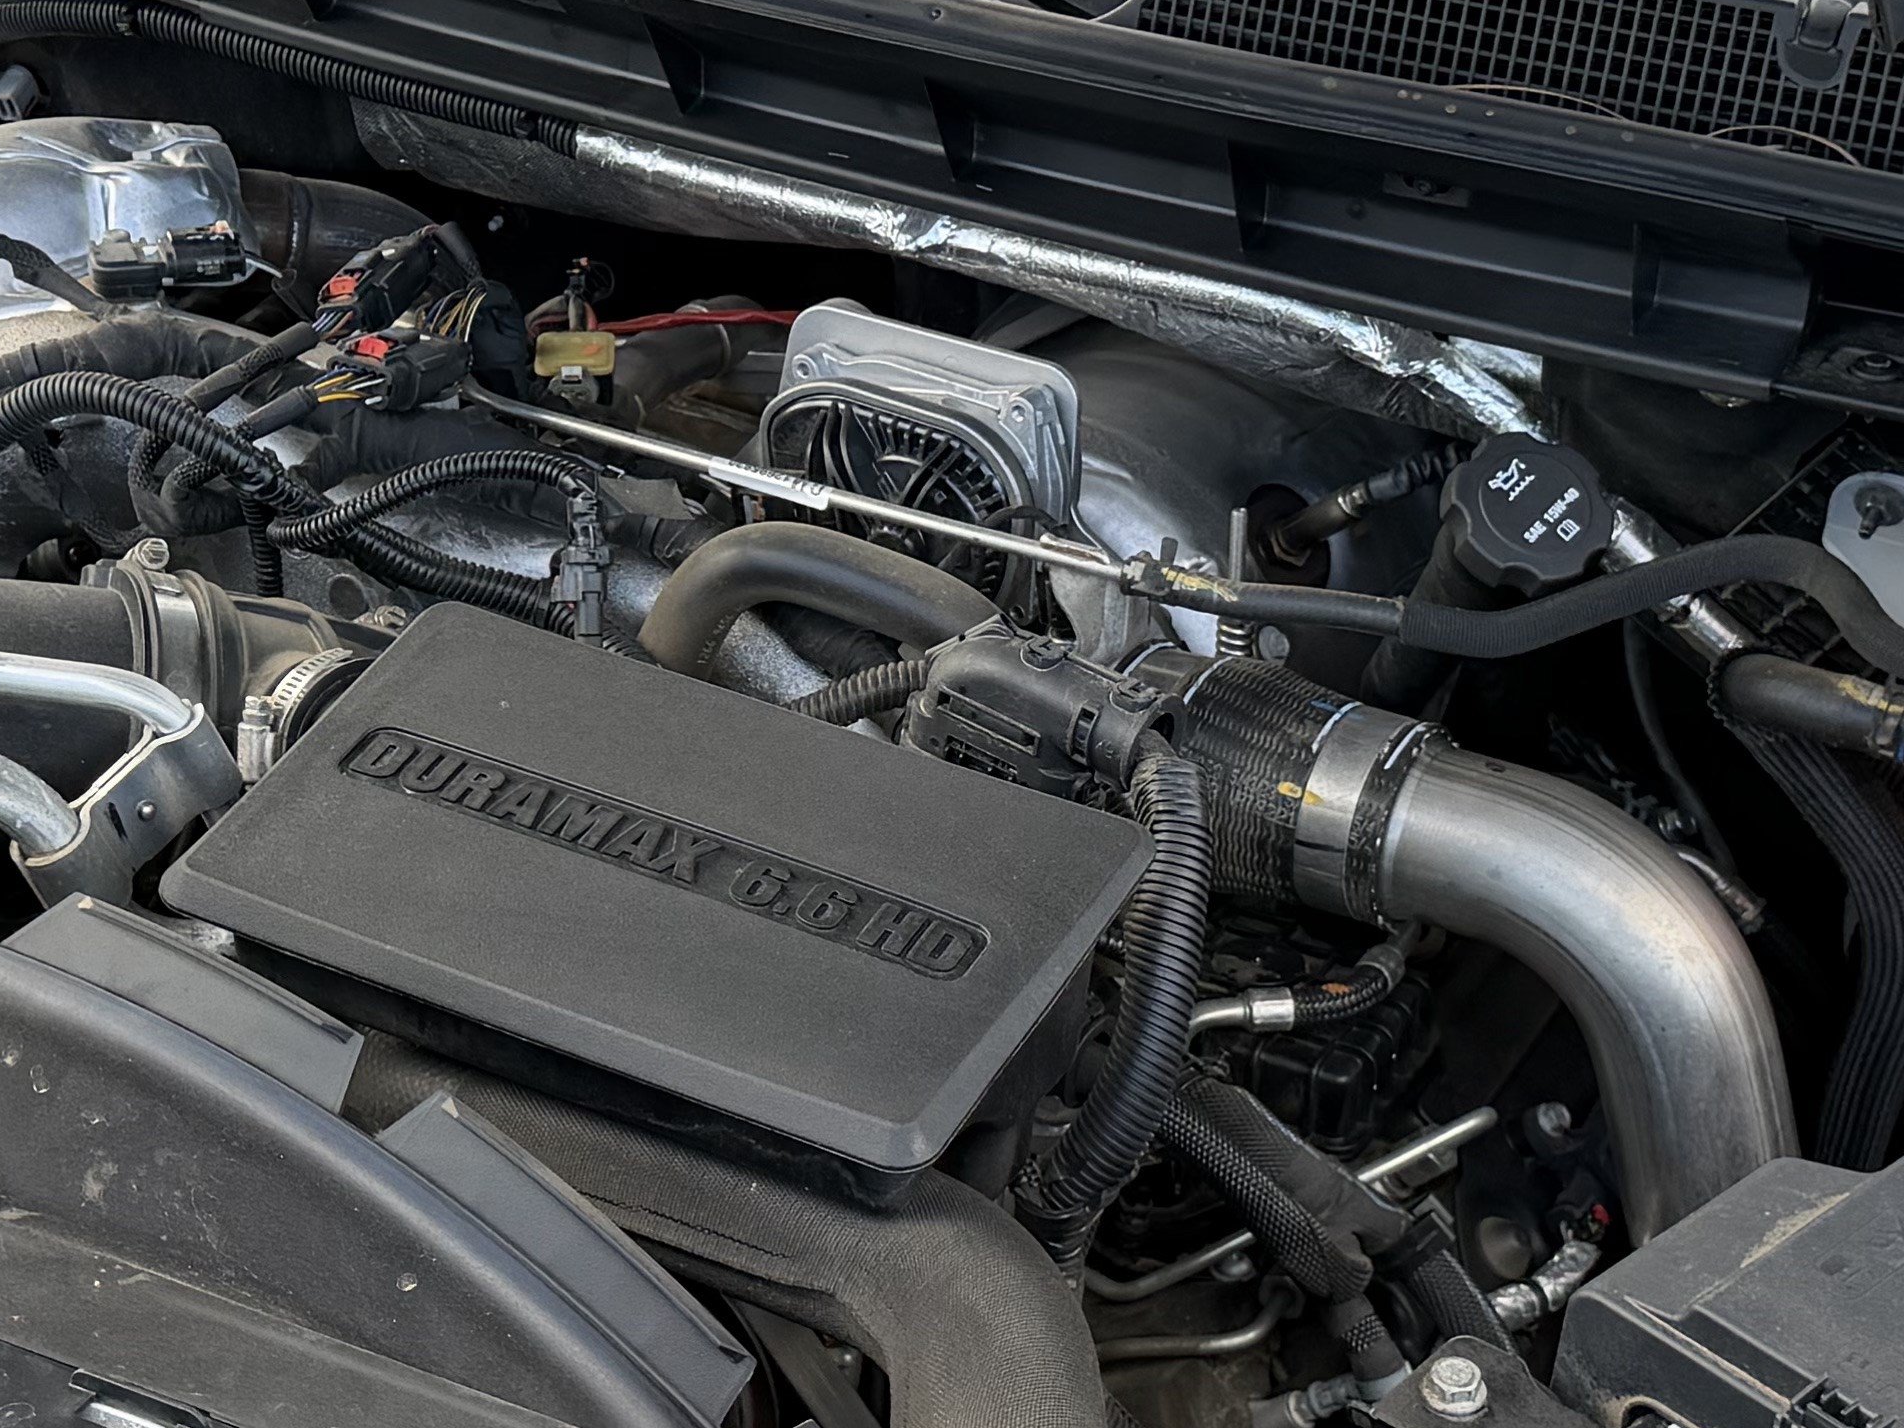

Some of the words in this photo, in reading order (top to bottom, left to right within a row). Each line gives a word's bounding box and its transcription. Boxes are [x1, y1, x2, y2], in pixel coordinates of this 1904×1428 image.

[1523, 519, 1548, 544] SAE
[1542, 486, 1581, 524] 15W-40
[349, 736, 725, 884] DURAMAX
[728, 857, 858, 930] 6.6
[854, 900, 980, 975] HD
